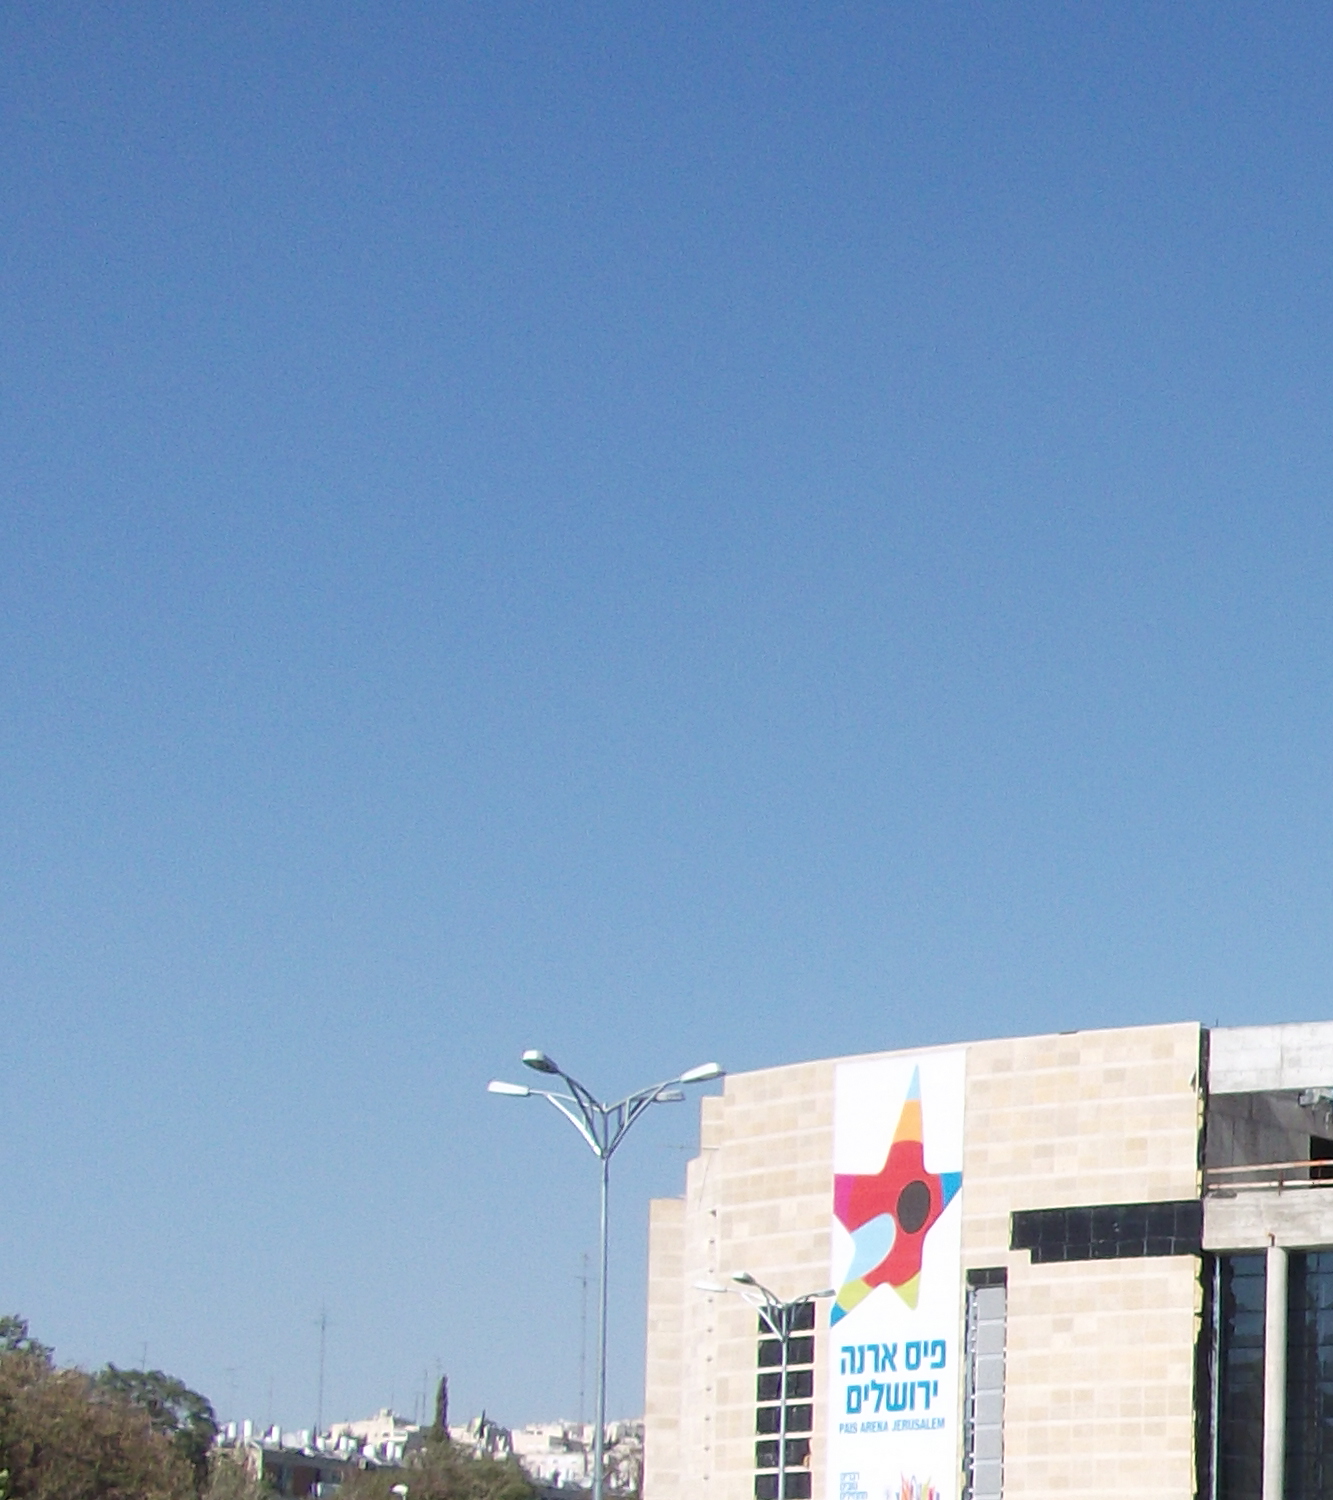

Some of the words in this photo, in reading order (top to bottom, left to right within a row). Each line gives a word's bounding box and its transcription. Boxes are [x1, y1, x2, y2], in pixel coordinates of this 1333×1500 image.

[840, 1341, 898, 1376] ארנה
[905, 1339, 946, 1371] פיס
[845, 1379, 939, 1415] ירושלים
[839, 1422, 858, 1434] PAIS
[860, 1420, 889, 1433] ARENA
[891, 1417, 945, 1432] JERUSALEM
